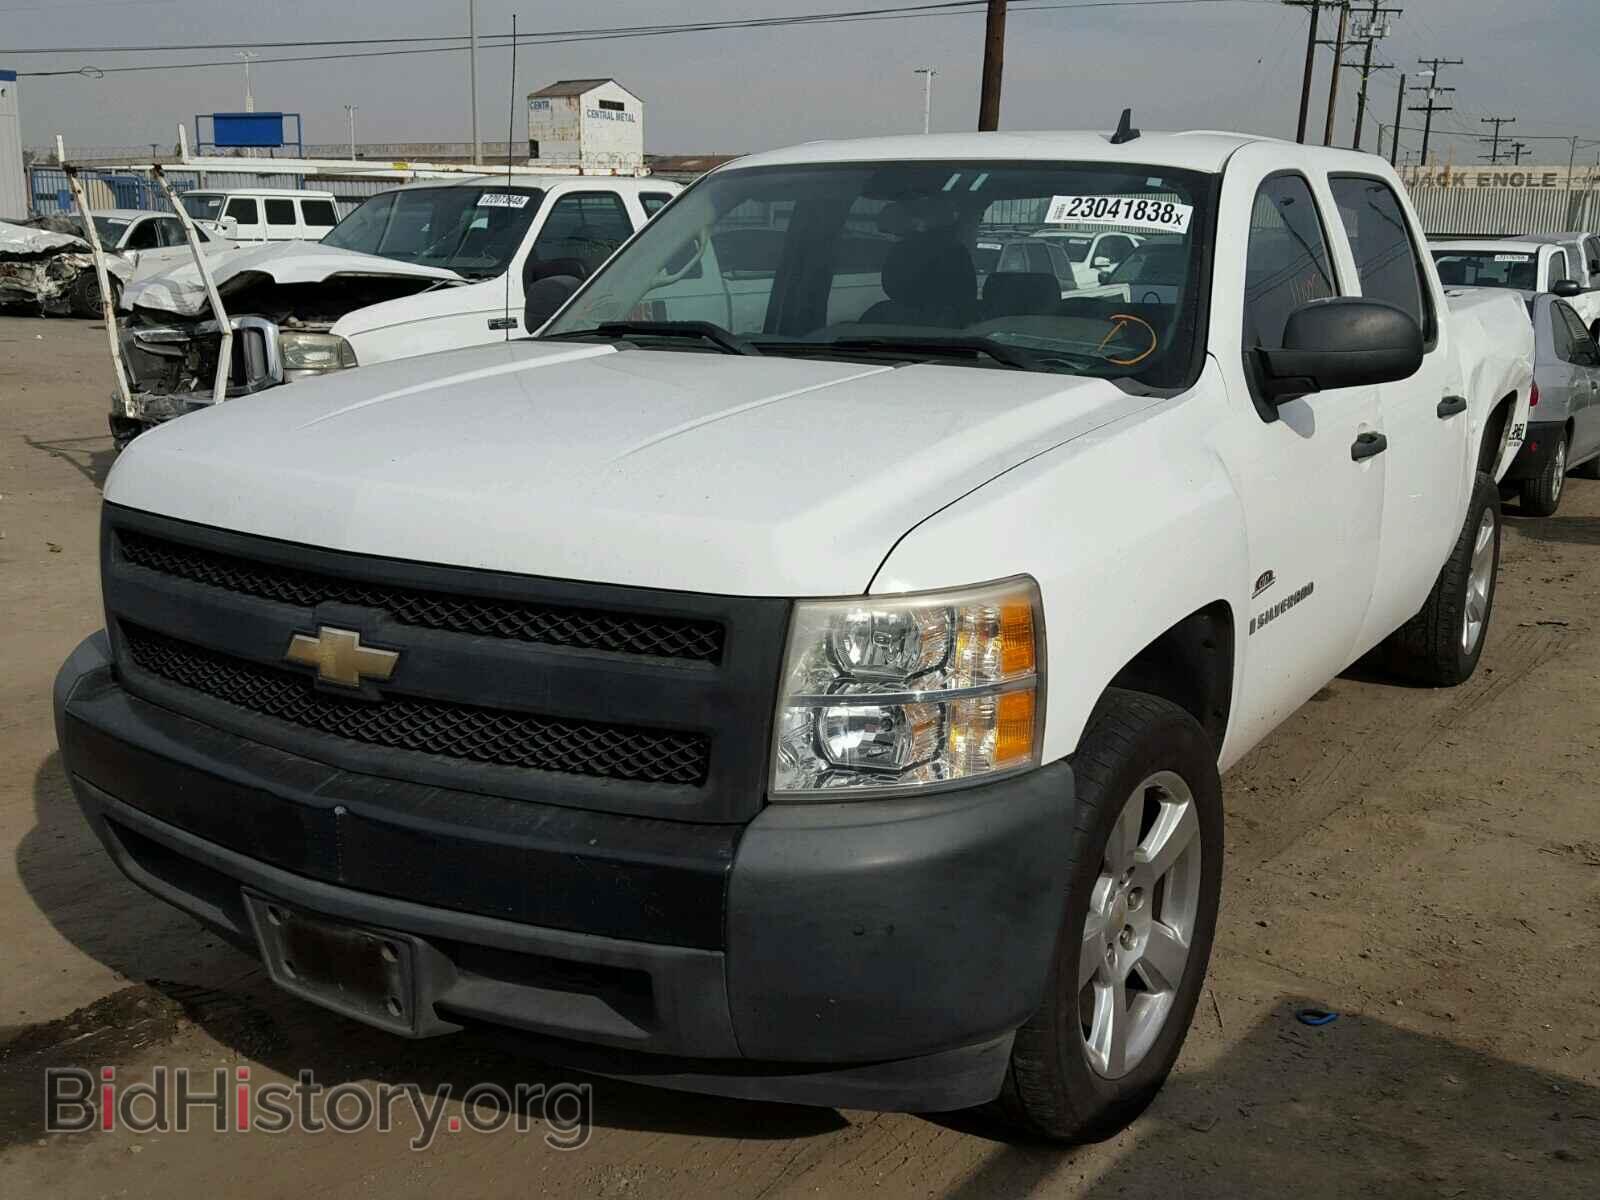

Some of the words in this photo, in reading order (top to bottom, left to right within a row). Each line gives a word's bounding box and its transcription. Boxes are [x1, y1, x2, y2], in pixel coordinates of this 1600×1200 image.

[586, 109, 614, 120] CENTRAL
[616, 111, 636, 122] METAL
[1477, 172, 1557, 187] ENGLE
[1257, 581, 1314, 629] SILVERADO
